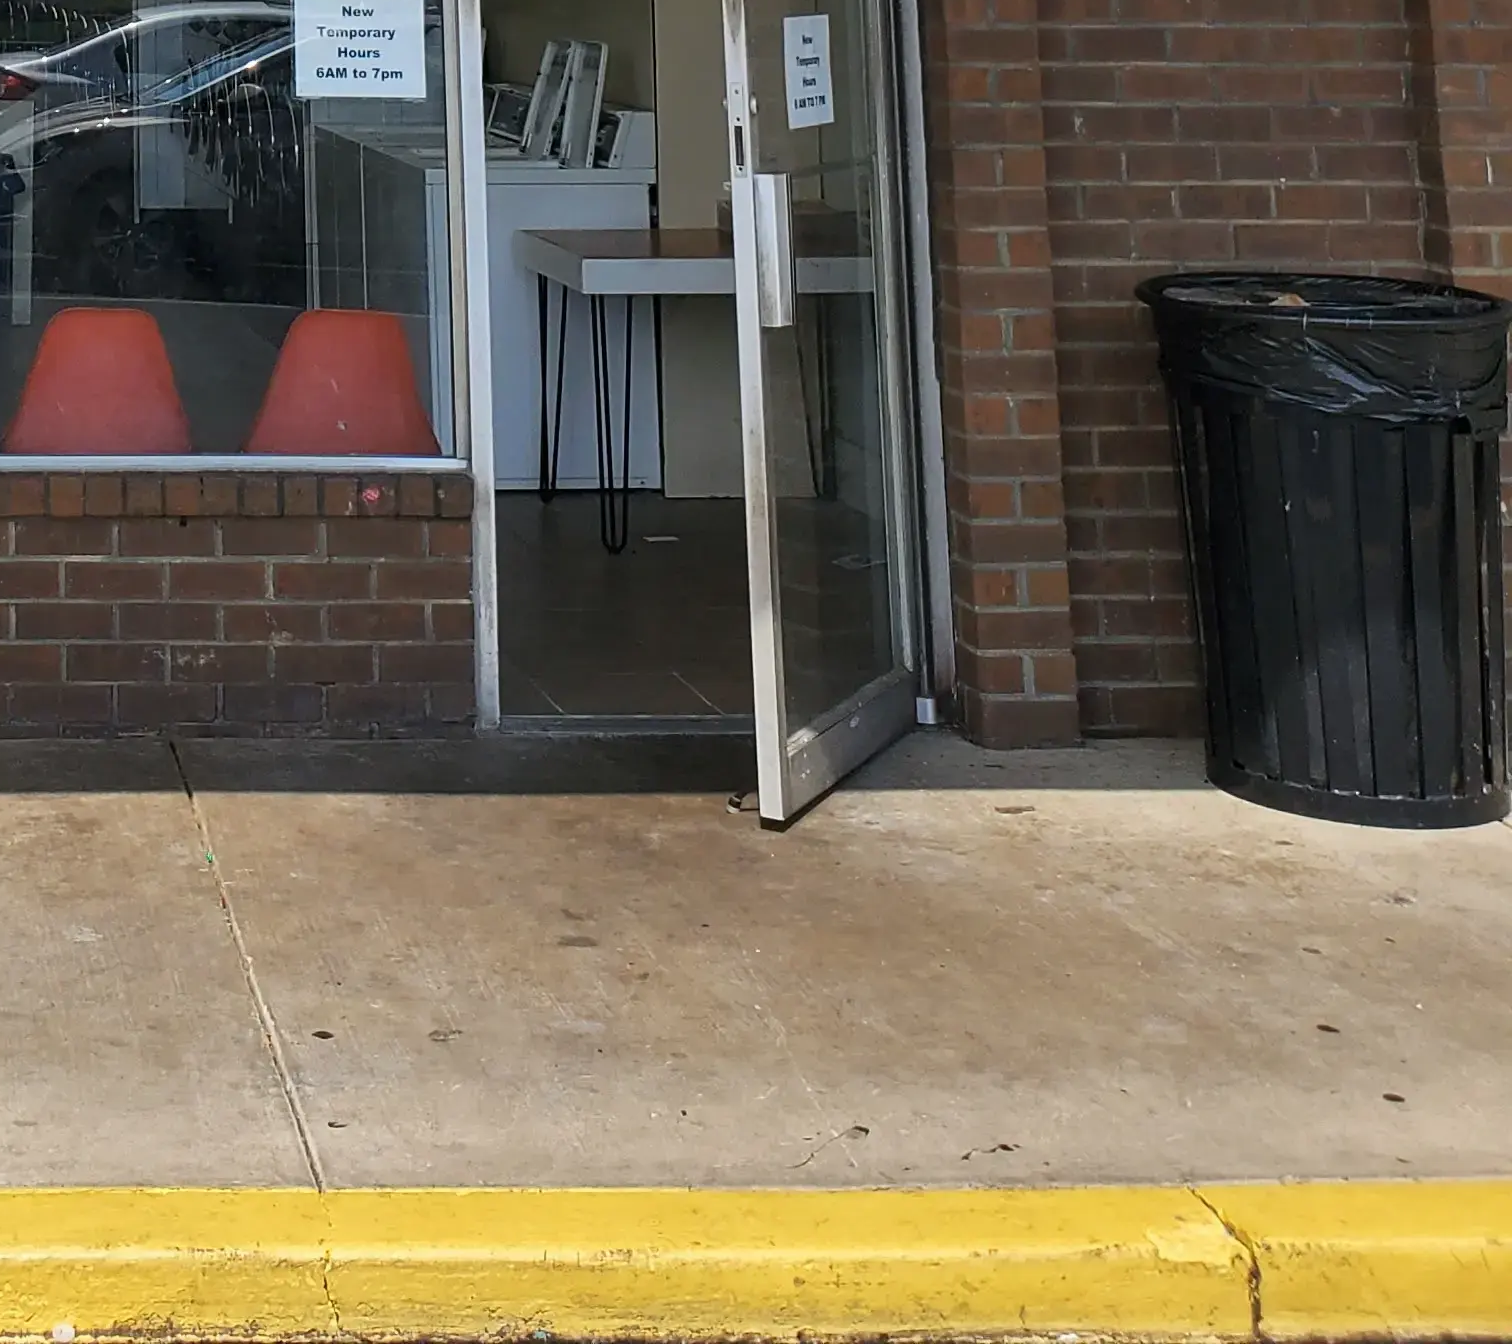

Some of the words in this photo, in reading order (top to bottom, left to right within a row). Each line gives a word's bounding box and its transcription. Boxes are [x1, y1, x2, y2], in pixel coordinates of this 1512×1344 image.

[342, 6, 374, 17] New
[316, 26, 396, 40] Temporary
[337, 47, 381, 58] Hours
[316, 67, 348, 79] 6AM
[353, 68, 367, 79] to
[372, 68, 403, 82] 7pm
